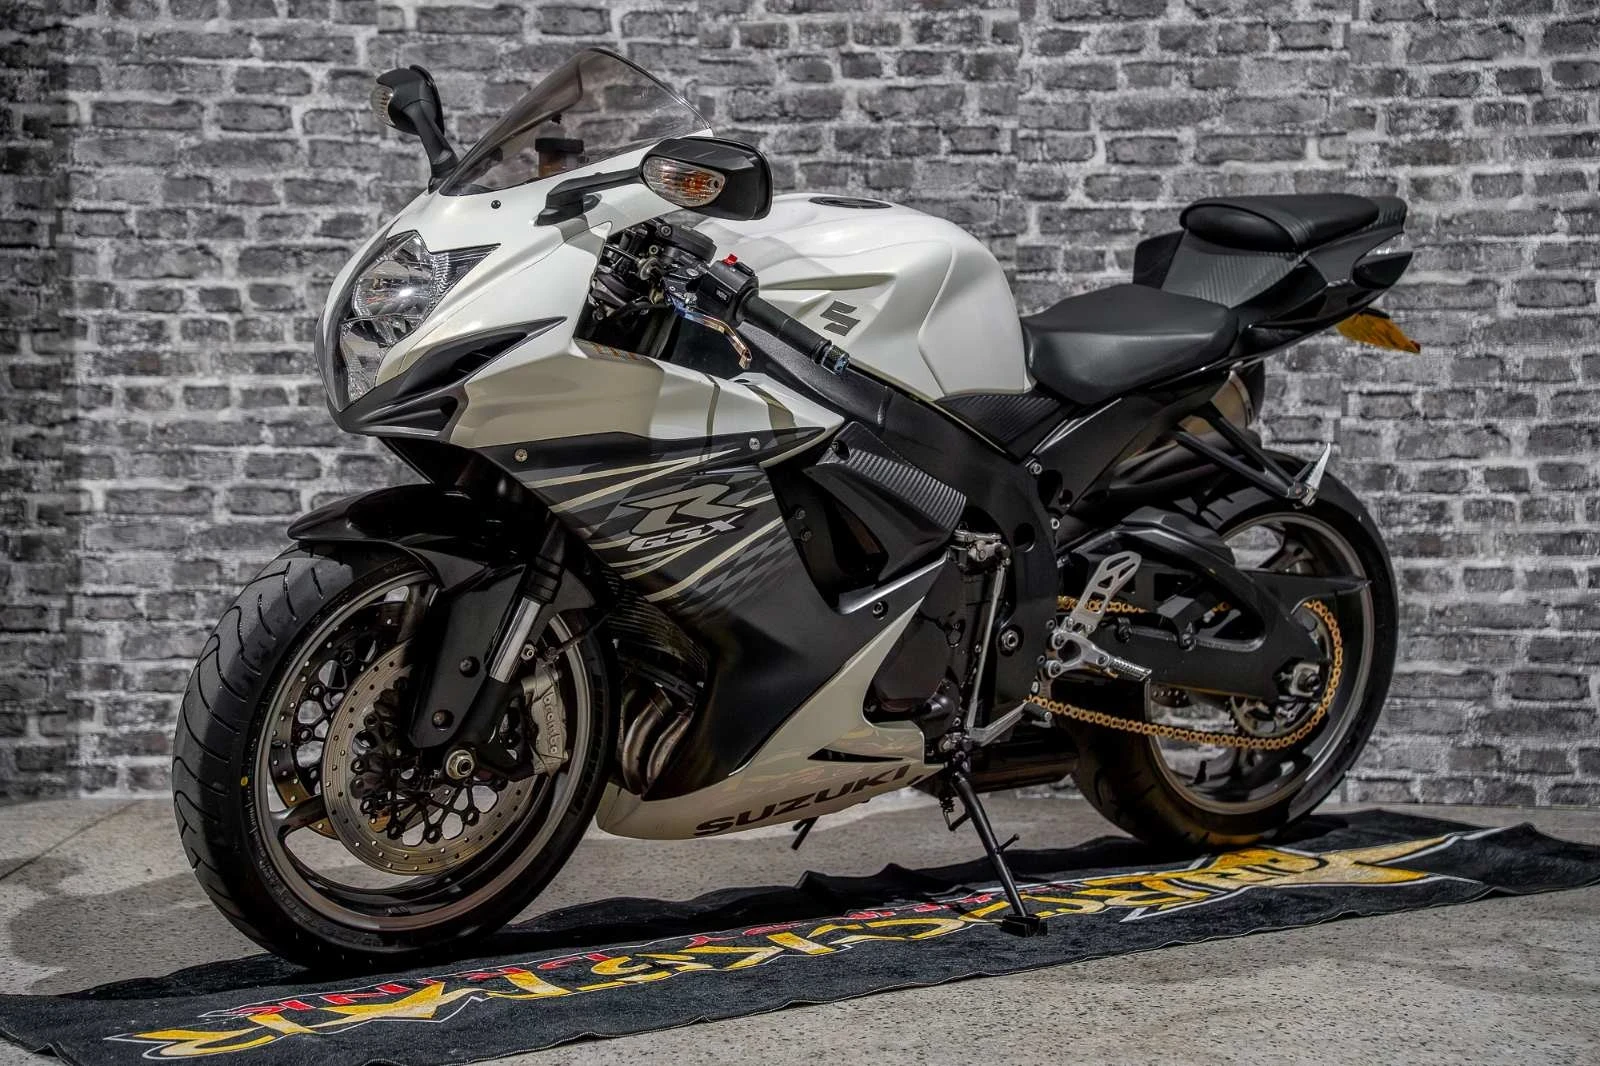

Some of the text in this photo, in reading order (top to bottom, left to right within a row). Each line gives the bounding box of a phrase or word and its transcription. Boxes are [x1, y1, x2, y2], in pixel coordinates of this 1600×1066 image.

[626, 513, 745, 552] GSX
[543, 691, 562, 754] brembo
[693, 765, 911, 837] SUZUKI
